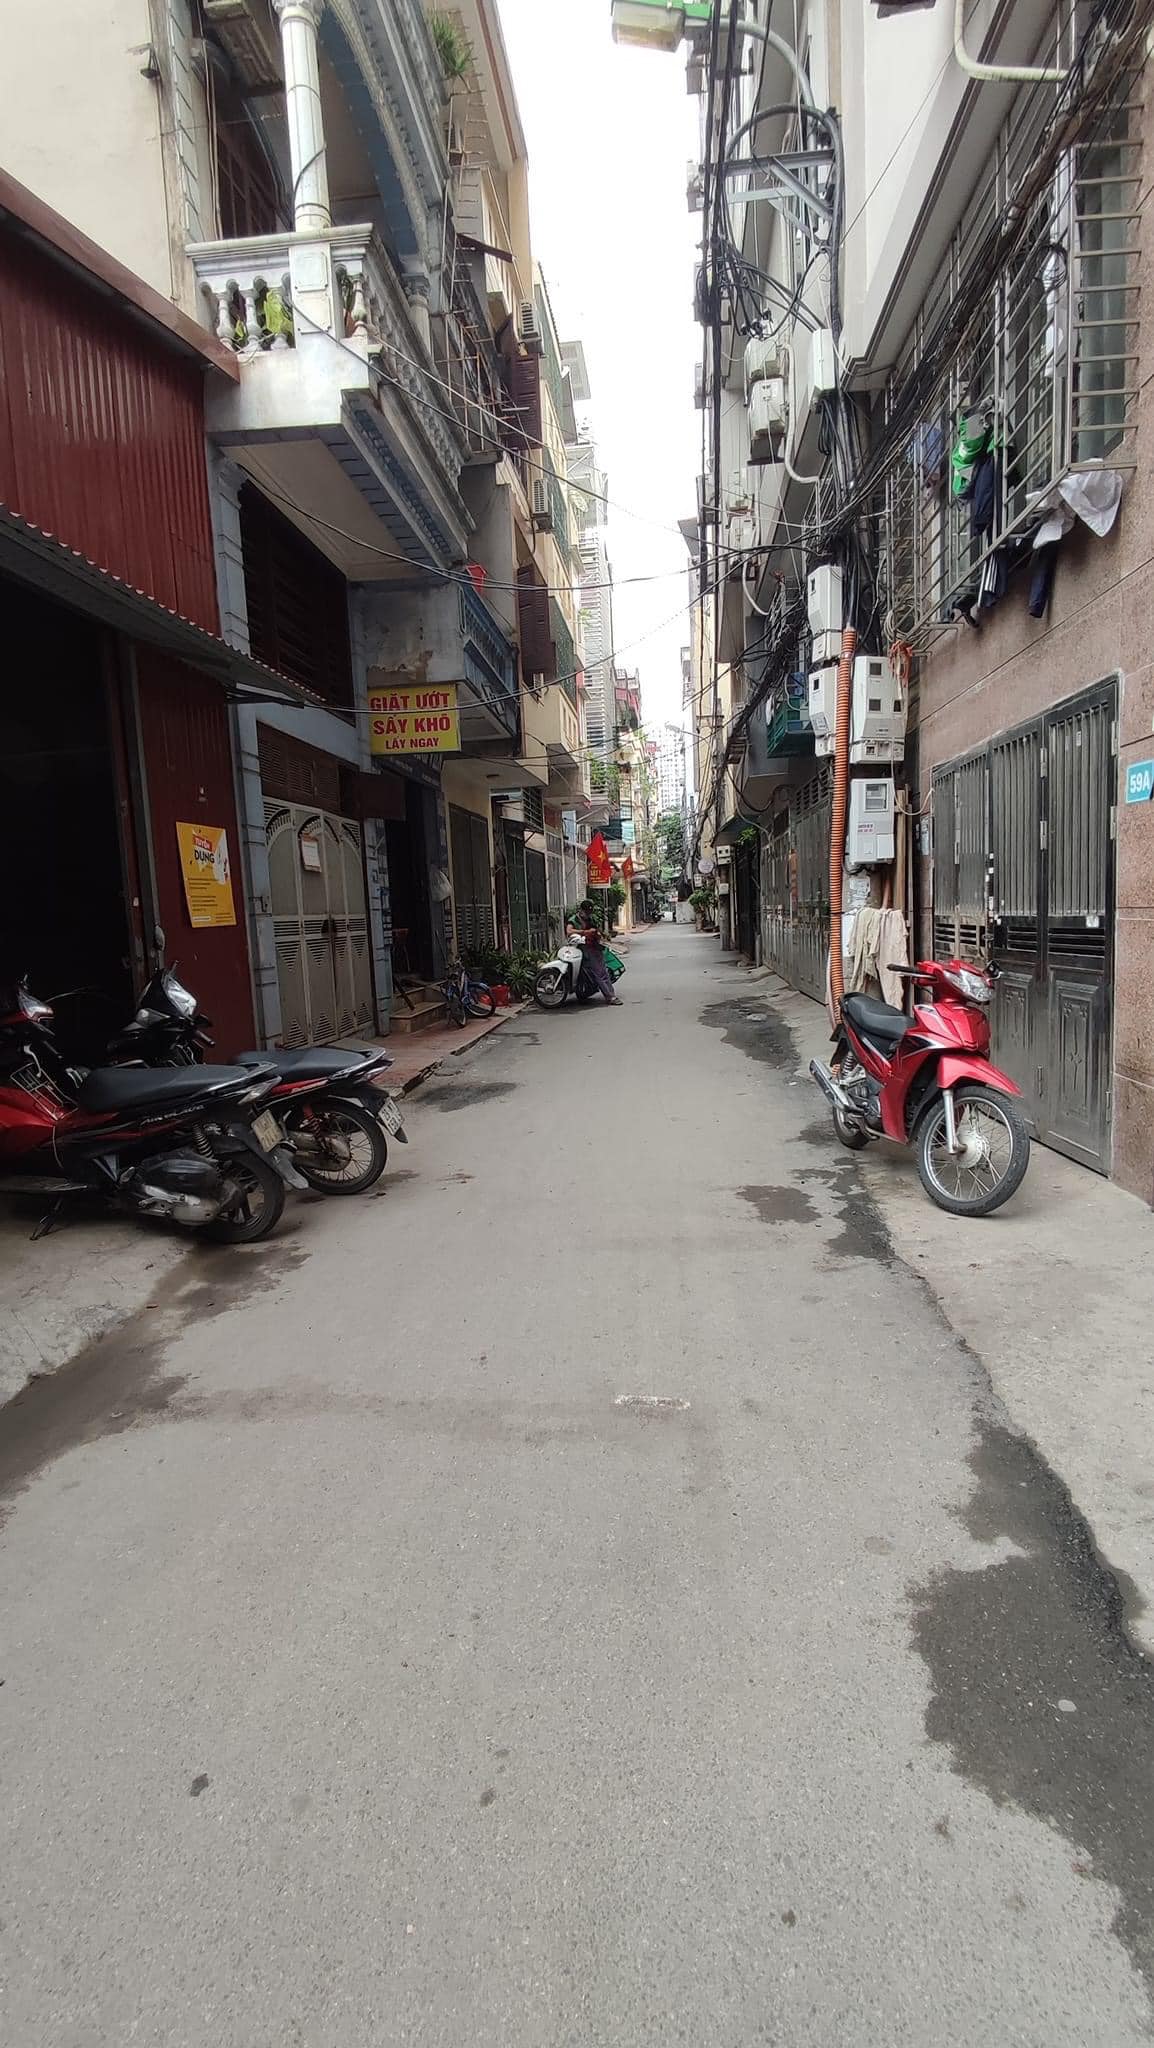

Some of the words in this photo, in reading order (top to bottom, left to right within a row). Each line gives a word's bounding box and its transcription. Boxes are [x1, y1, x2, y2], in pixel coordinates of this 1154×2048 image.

[414, 713, 451, 733] KHÔ
[410, 737, 439, 748] NGAY
[1129, 770, 1151, 794] 59A
